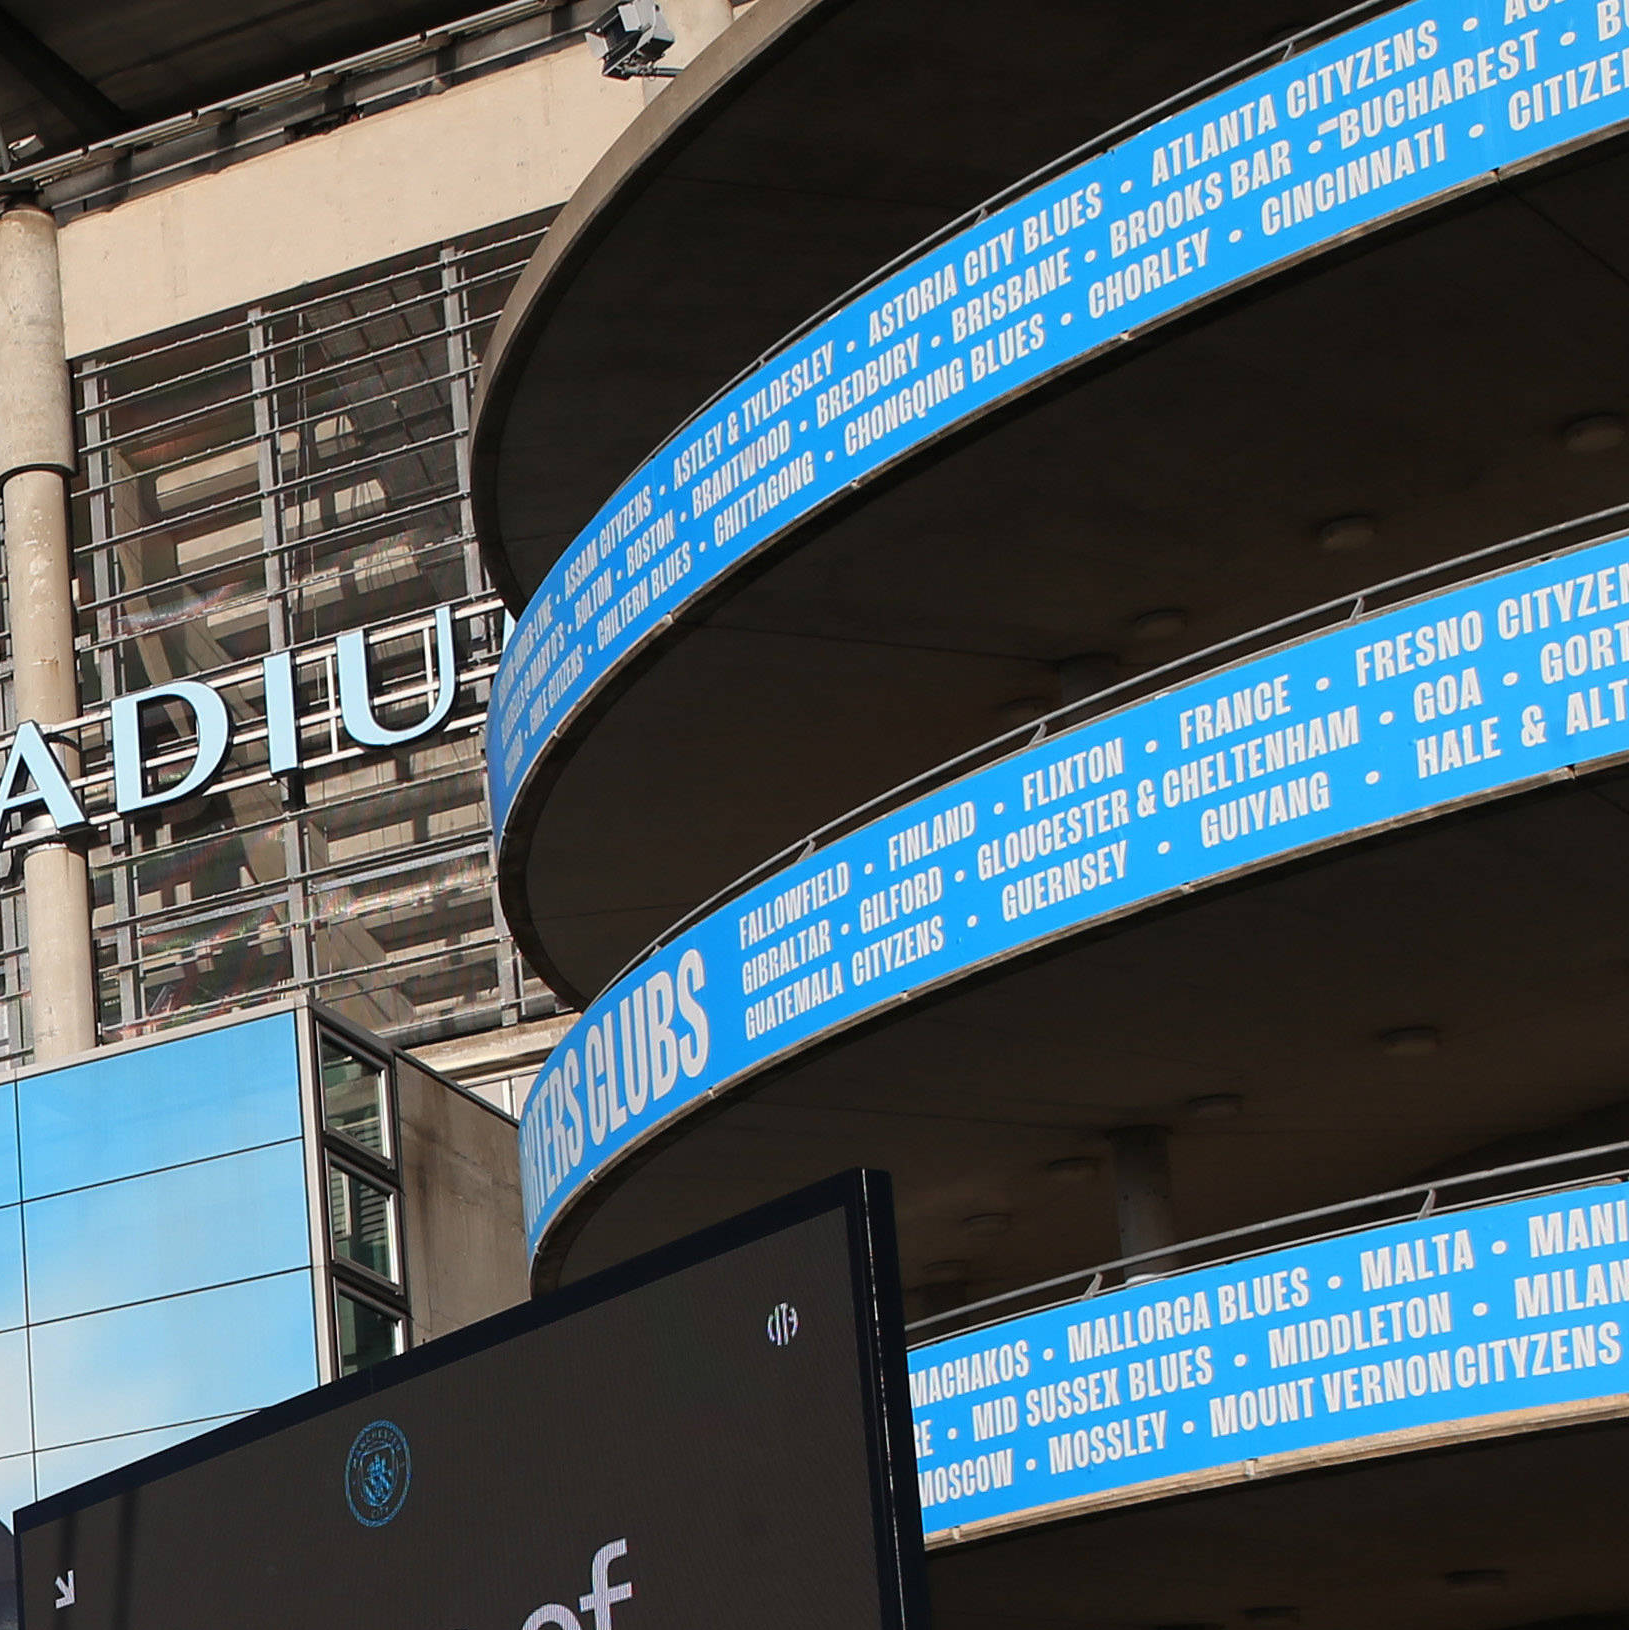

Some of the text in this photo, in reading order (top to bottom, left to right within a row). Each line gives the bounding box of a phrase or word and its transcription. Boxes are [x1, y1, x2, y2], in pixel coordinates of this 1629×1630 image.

[564, 19, 1438, 600] ASSAM CITYZENS ASTLEY & ASTORIA CITY ATLANTA CITYZENS
[574, 28, 1540, 632] BOLTON BRANTWOOD BREDBURY BRISBANE BAR BUCHAREST
[596, 577, 650, 651] CHILTERN
[651, 541, 692, 600] BLUES
[844, 357, 965, 457] CHONGQING
[970, 312, 1046, 383] BLUES
[1261, 122, 1446, 237] CINCINNATI
[739, 674, 1292, 950] FALLOWFIELD FLIXTON FRANCE
[742, 918, 832, 995] GIBRALTAR
[859, 866, 943, 934] GILFORD
[1136, 778, 1157, 818] &
[1162, 705, 1360, 809] CHELTENHAM
[1412, 667, 1483, 723] GOA
[851, 915, 945, 987] CITYZENS
[1001, 840, 1129, 922] GUERNSEY
[1199, 770, 1330, 849] GUIYANG
[1520, 703, 1547, 749] &
[585, 948, 710, 1146] CLUBS
[909, 1340, 1030, 1409] MACHAKOS
[1067, 1289, 1211, 1364] MALLORCA
[1217, 1266, 1311, 1328] BLUES
[918, 1321, 1622, 1508] MOSCOW MOSSLEY VERNON CITYZENS
[972, 1396, 1018, 1442] MID
[1026, 1367, 1119, 1427] SUSSEX
[1268, 1291, 1452, 1369] MIDDLETON
